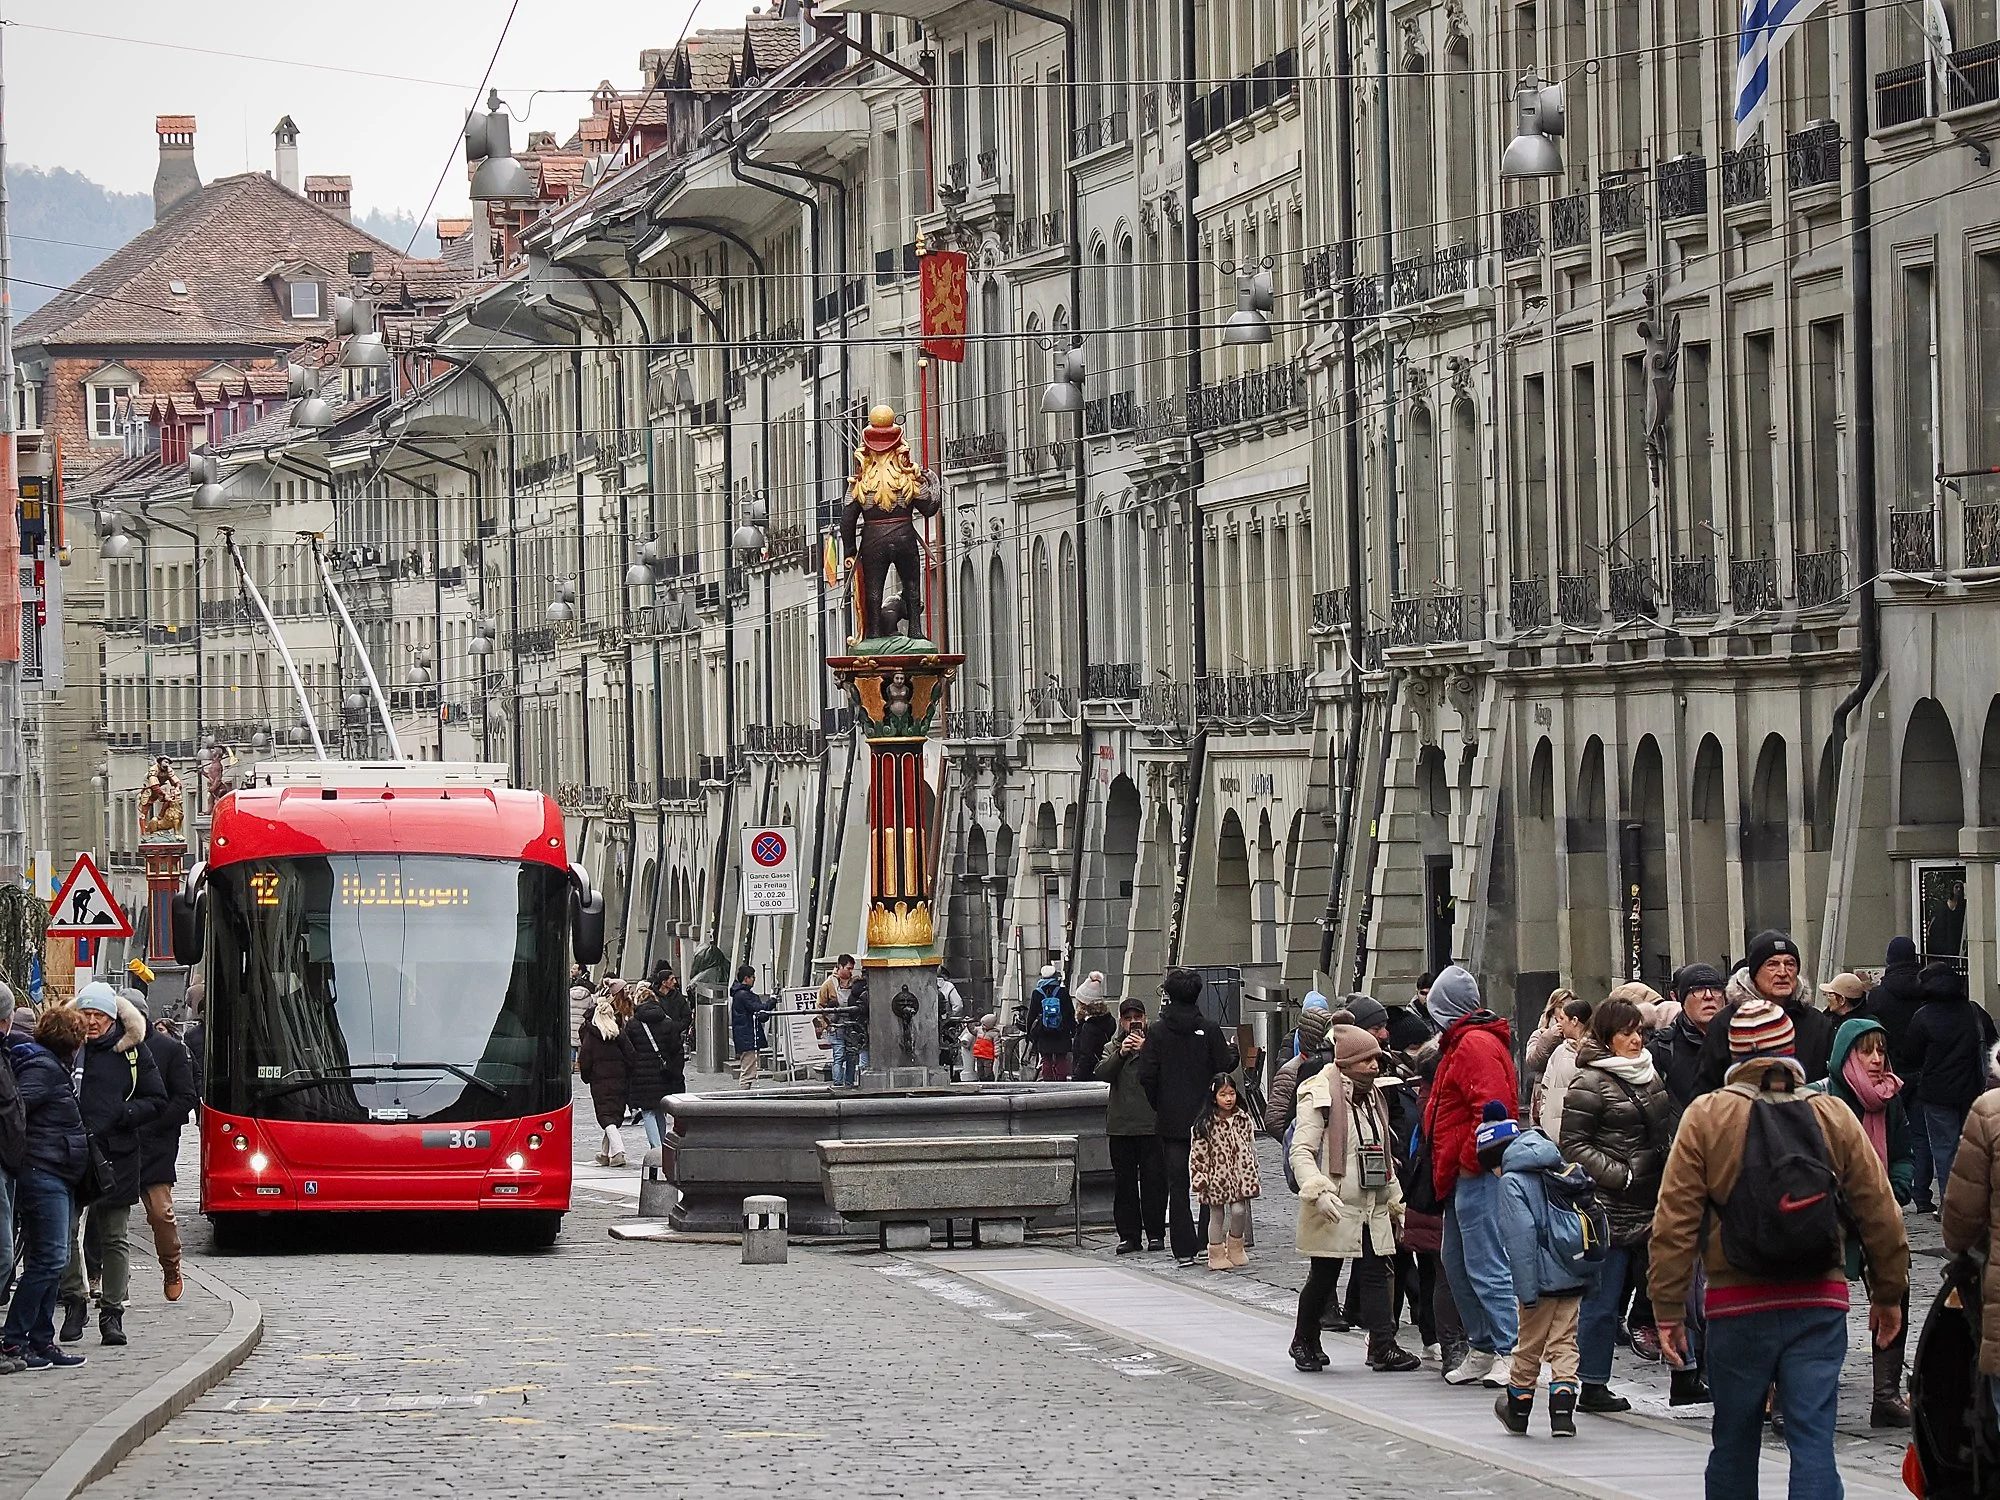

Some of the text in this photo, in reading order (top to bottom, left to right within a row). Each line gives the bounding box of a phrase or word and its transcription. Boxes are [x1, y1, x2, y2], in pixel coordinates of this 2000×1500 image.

[248, 872, 469, 907] 12 Holligen
[368, 1108, 409, 1120] HESS
[448, 1130, 478, 1149] 36
